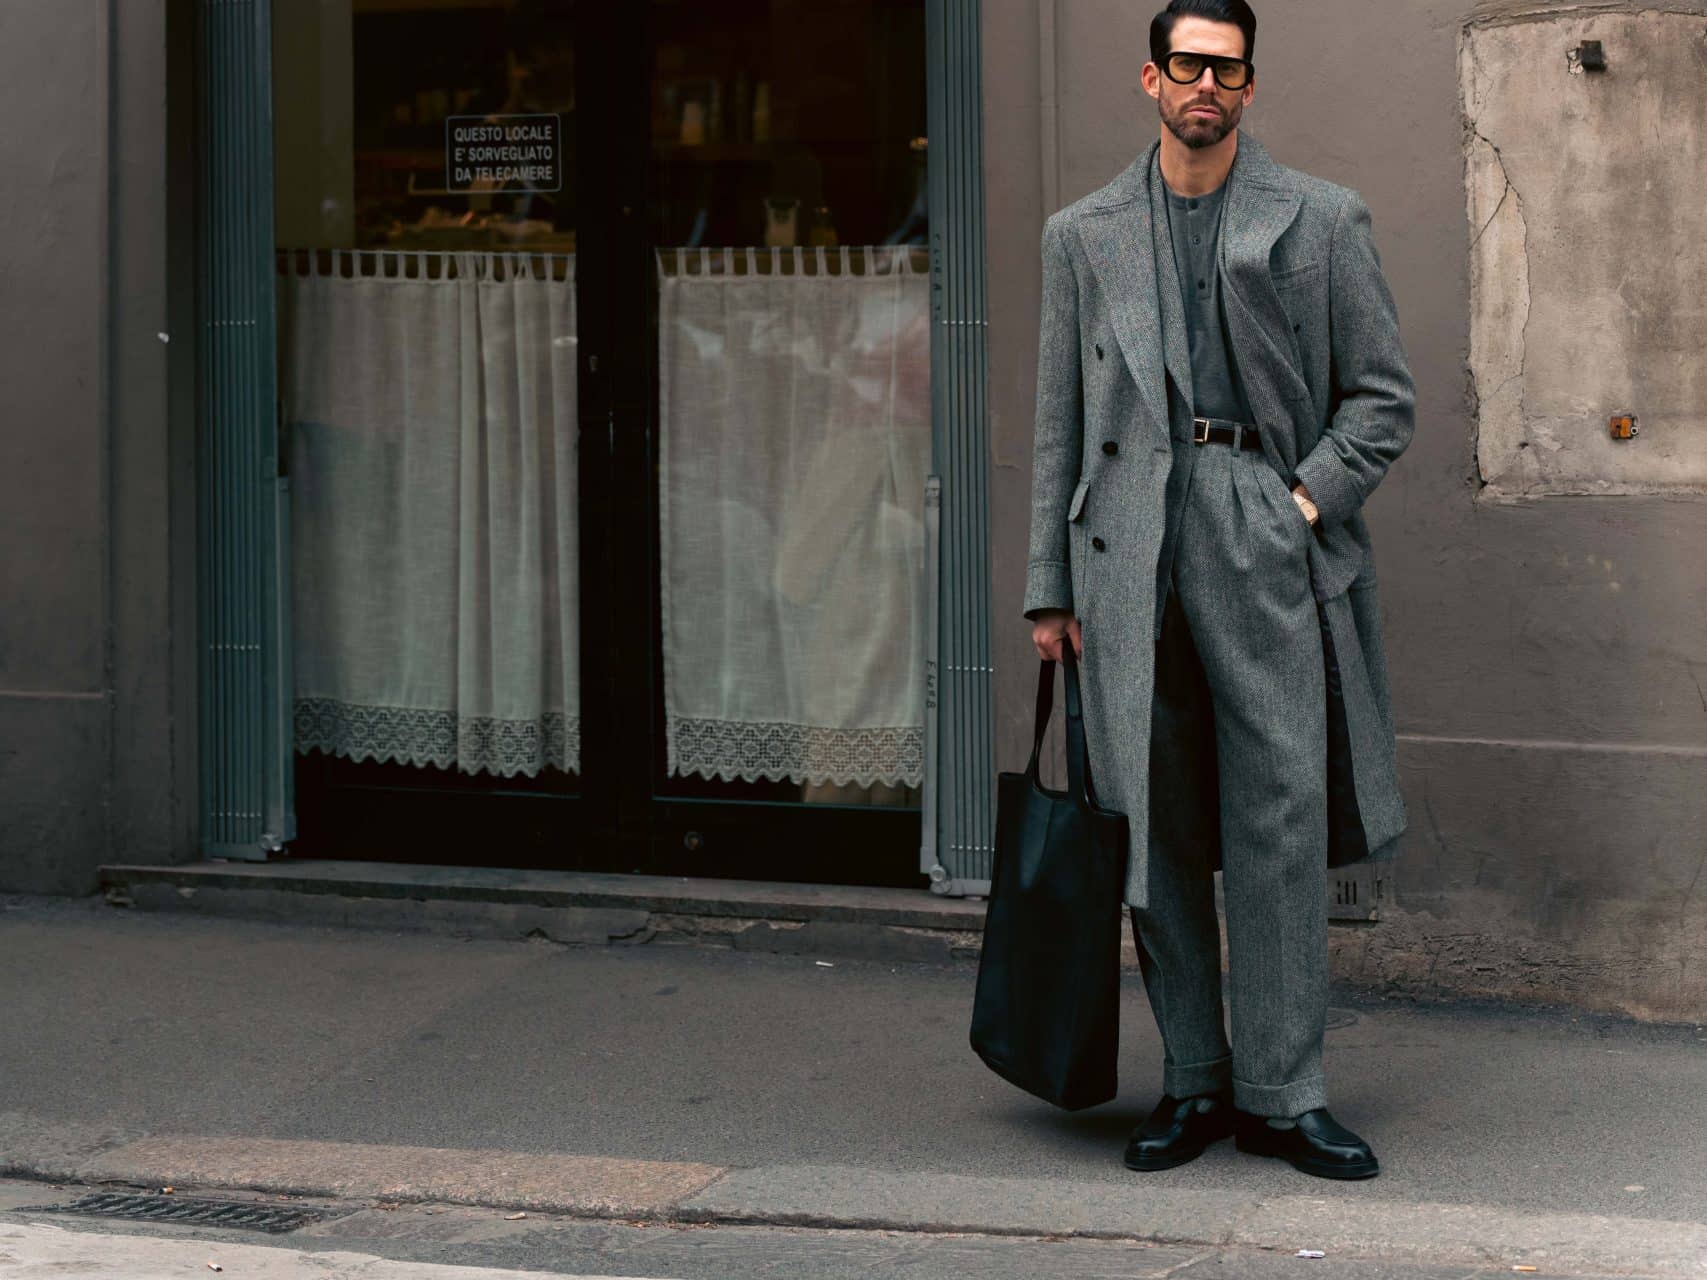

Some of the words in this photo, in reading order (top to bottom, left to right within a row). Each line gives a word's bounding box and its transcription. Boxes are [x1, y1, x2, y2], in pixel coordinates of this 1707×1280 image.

[454, 126, 502, 141] QUESTO
[505, 125, 552, 140] LOCALE
[468, 145, 552, 161] SORVEGLIATO
[455, 167, 472, 181] DA
[475, 165, 552, 181] TELECAMERE
